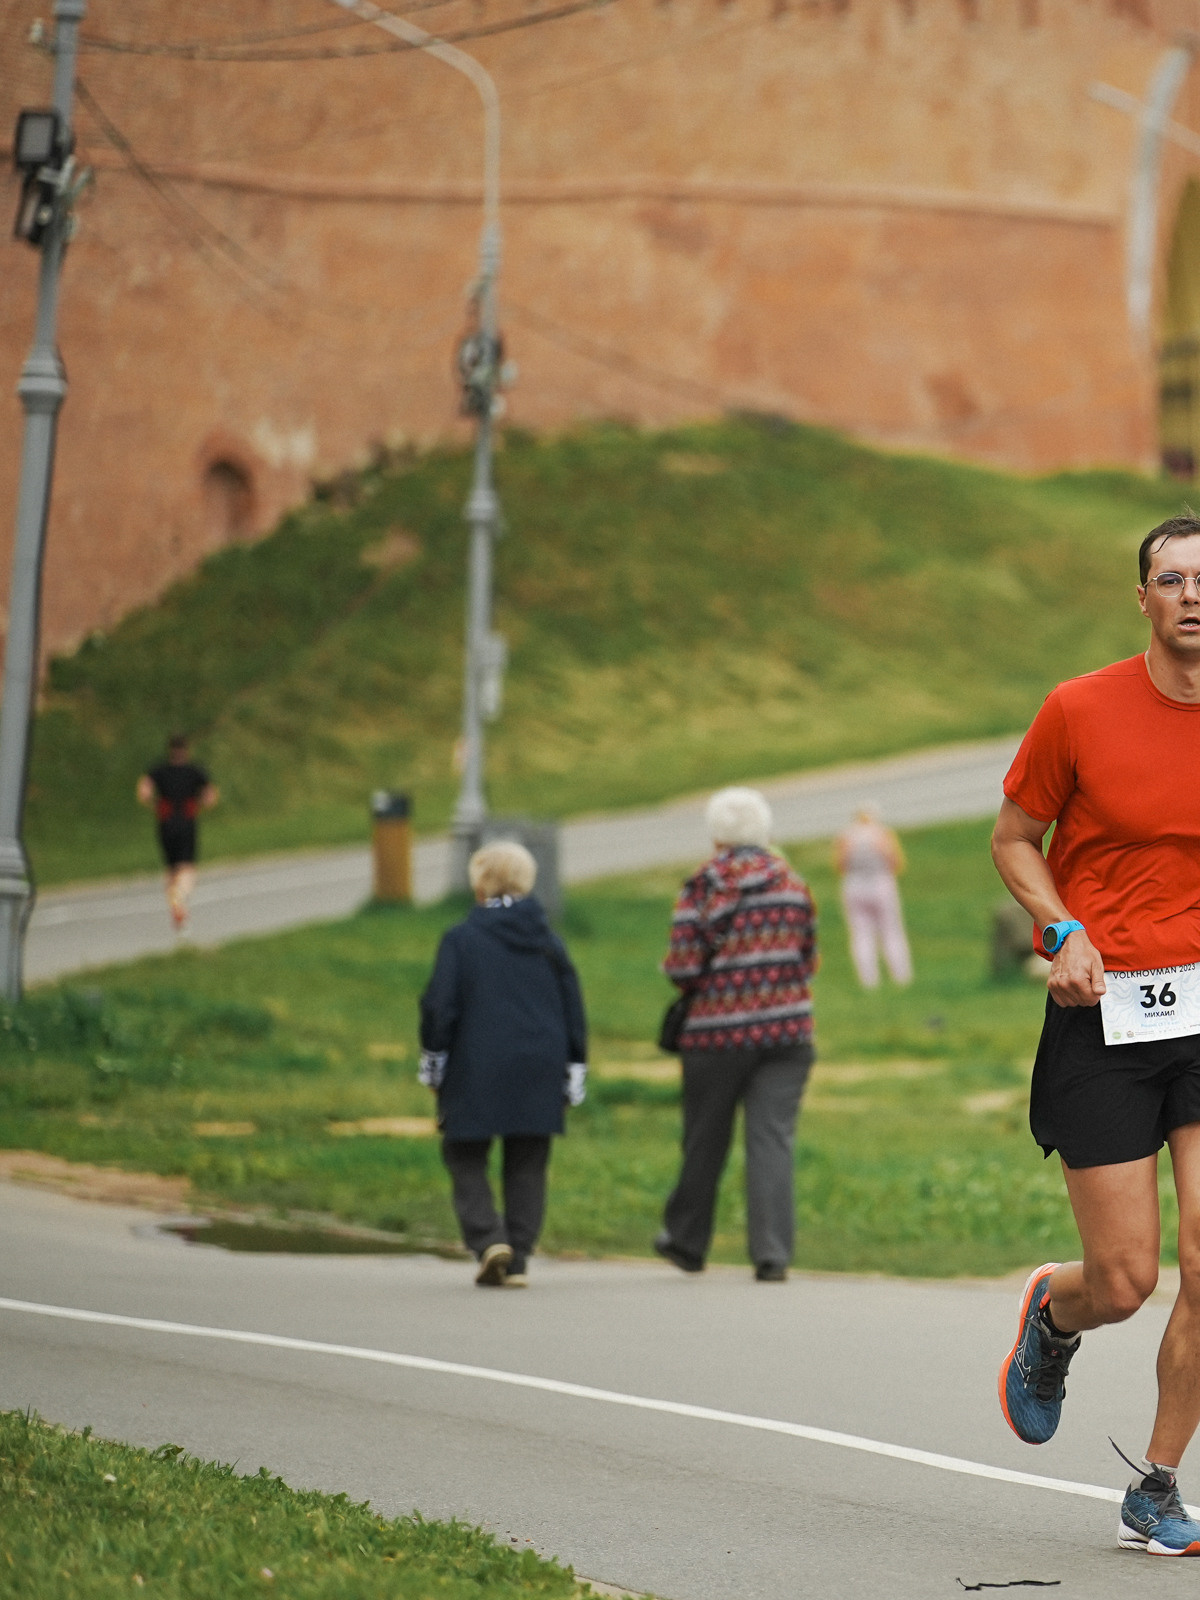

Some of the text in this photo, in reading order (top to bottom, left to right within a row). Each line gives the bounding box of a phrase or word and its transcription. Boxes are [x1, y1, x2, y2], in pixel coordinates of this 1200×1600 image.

[1113, 963, 1196, 979] VOLKHOVMAN 2023
[1140, 982, 1176, 1008] 36
[1144, 1010, 1175, 1018] МИХАИЛ
